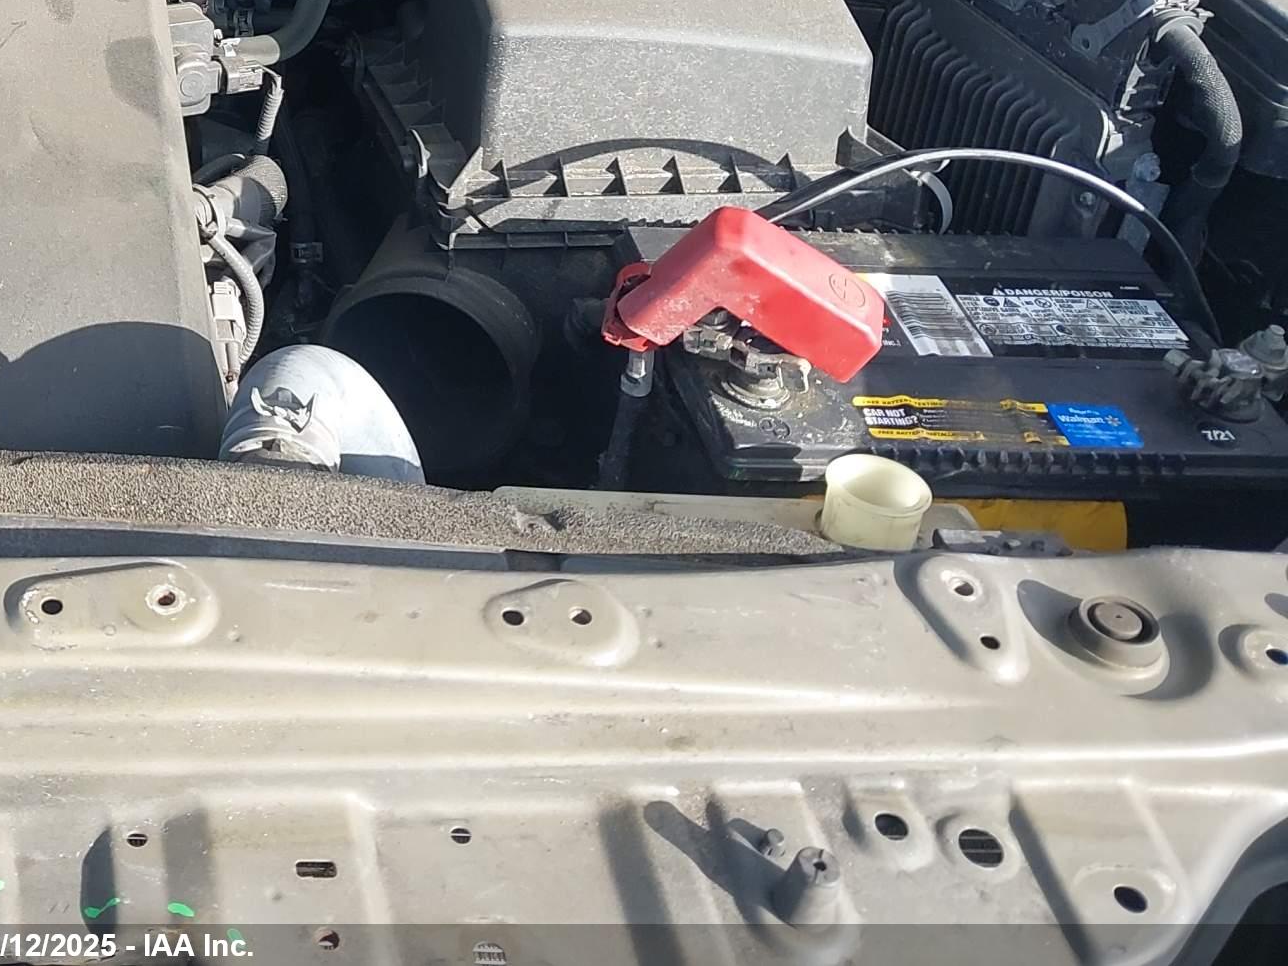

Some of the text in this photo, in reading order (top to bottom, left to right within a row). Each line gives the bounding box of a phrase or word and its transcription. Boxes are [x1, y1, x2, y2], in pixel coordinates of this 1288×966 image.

[1004, 288, 1114, 298] DANGER/POISON
[863, 408, 905, 417] CAR NOT
[865, 415, 919, 426] STARTING?
[1201, 429, 1236, 441] 7/21
